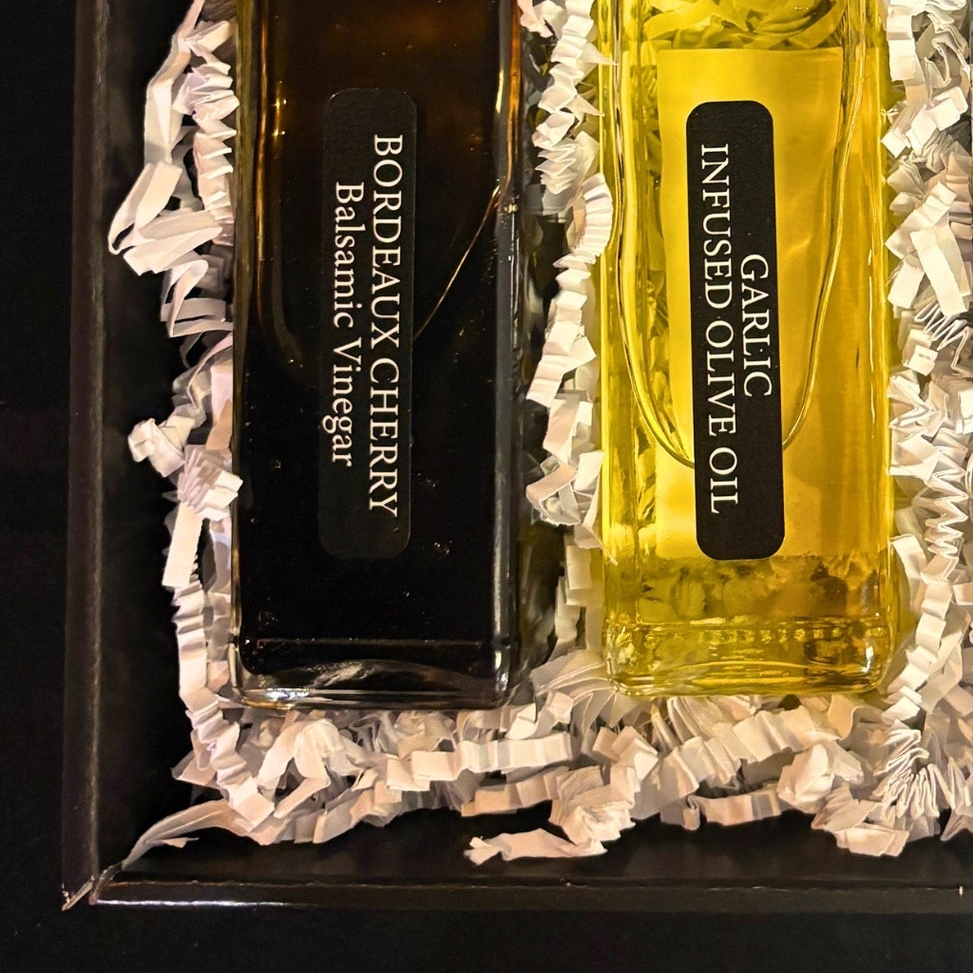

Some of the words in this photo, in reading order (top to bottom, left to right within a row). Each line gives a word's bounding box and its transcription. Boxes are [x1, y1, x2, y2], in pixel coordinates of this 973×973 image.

[333, 181, 366, 328] Balsamic
[370, 134, 403, 350] BORDEAUX
[701, 143, 733, 309] INFUSED
[705, 320, 737, 437] OLIVE
[740, 254, 773, 397] GARLIC
[321, 336, 362, 467] Vinegar
[368, 357, 400, 518] CHERRY
[709, 447, 739, 514] OIL
